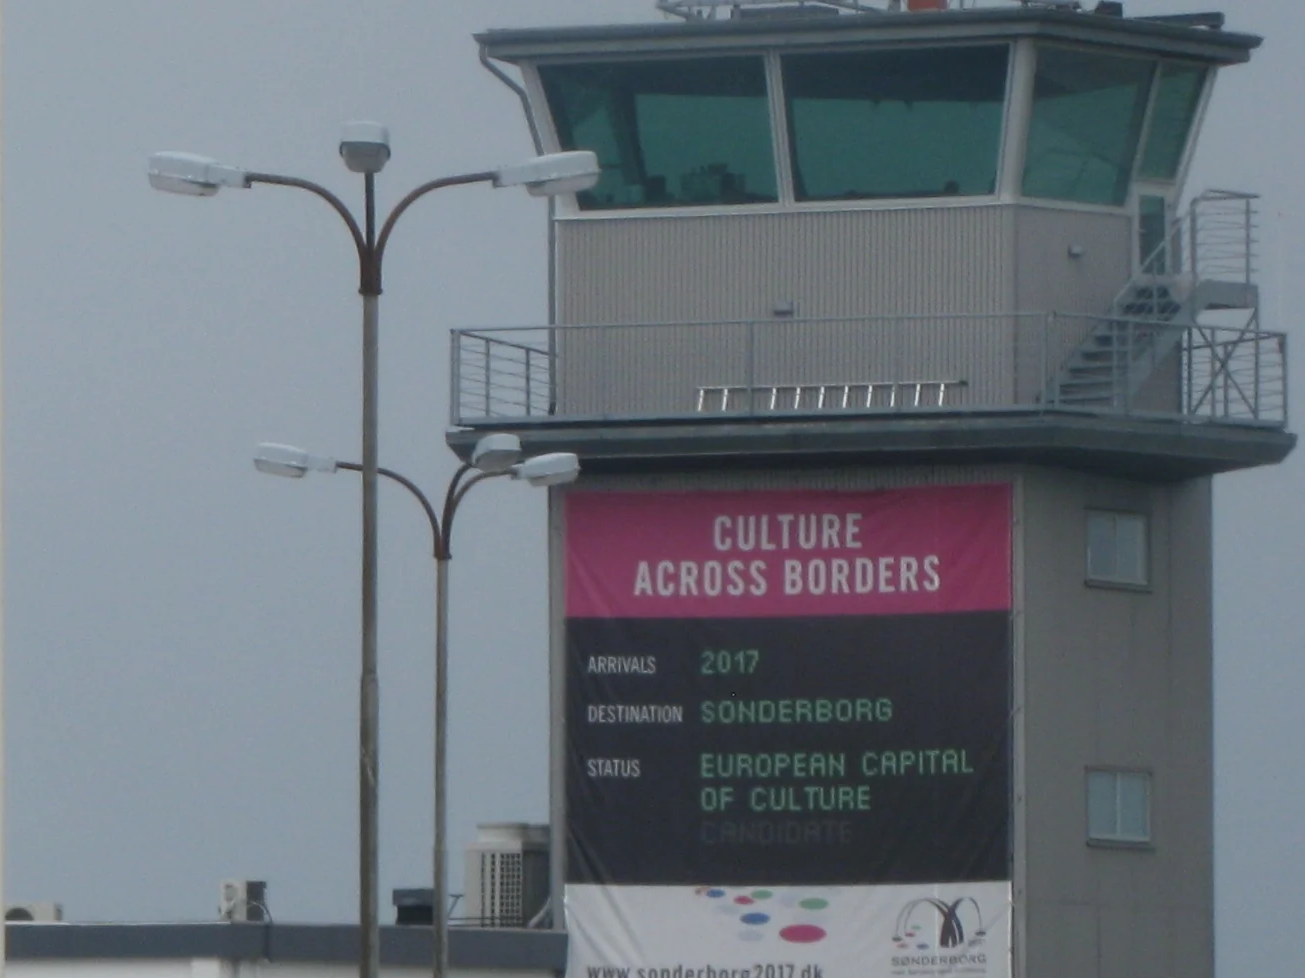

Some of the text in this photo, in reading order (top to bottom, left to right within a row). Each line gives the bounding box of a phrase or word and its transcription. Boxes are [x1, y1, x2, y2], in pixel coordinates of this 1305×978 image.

[713, 512, 864, 552] CULTURE
[633, 554, 941, 597] ACROSS BORDERS
[587, 650, 760, 675] ARRIVALS 2017
[587, 698, 893, 724] DESTINATION SONDERBORG
[586, 748, 975, 778] STATUS EUROPEAN CAPITAL
[700, 785, 872, 812] OF CULTURE
